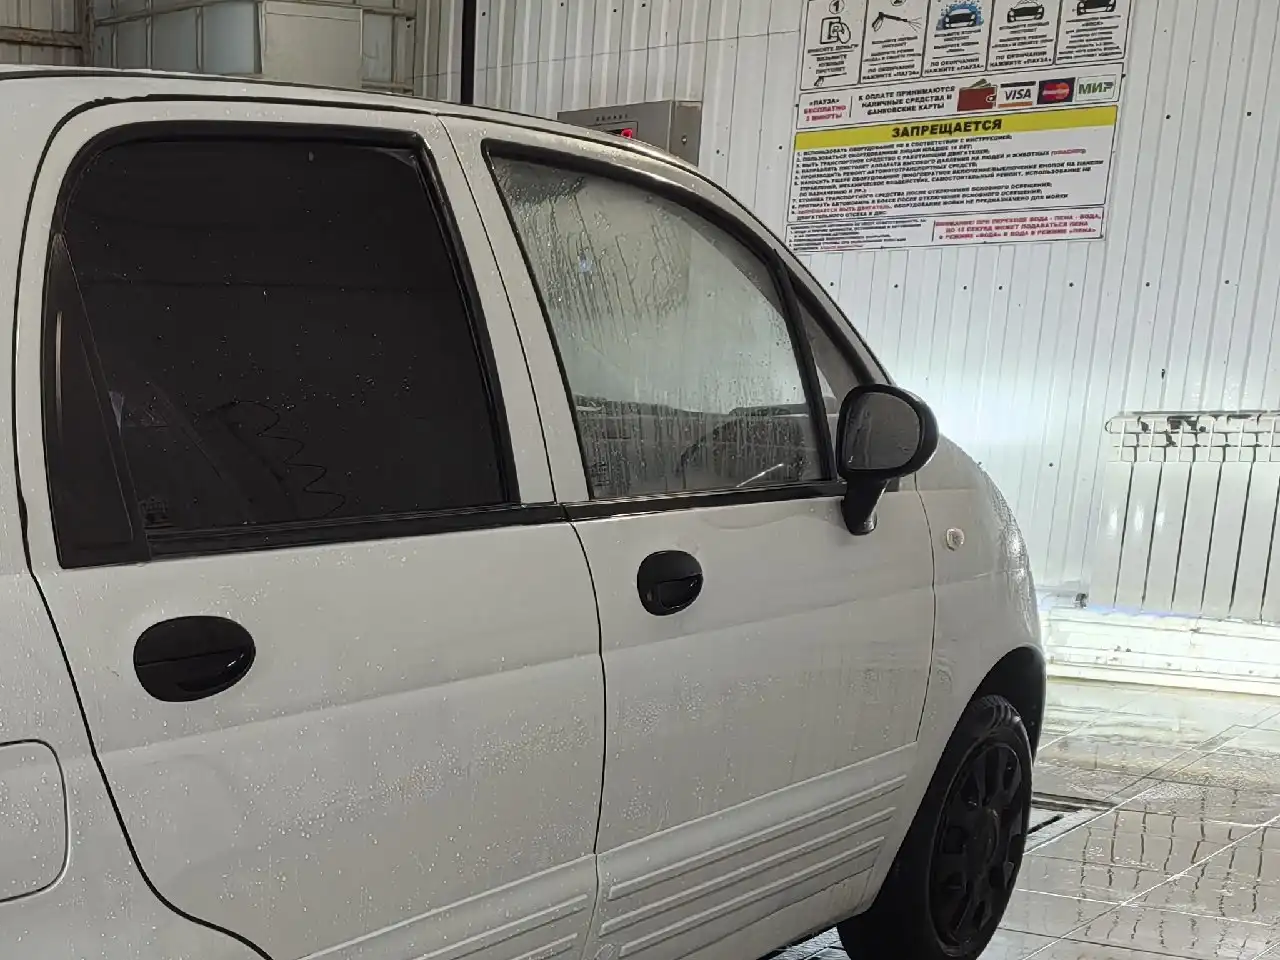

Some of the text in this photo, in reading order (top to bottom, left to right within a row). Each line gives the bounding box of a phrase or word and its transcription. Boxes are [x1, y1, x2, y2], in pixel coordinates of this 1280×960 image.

[1004, 88, 1032, 101] VISA
[1078, 81, 1114, 95] МИР
[892, 119, 1003, 138] ЗАПРЕЩАЕТСЯ
